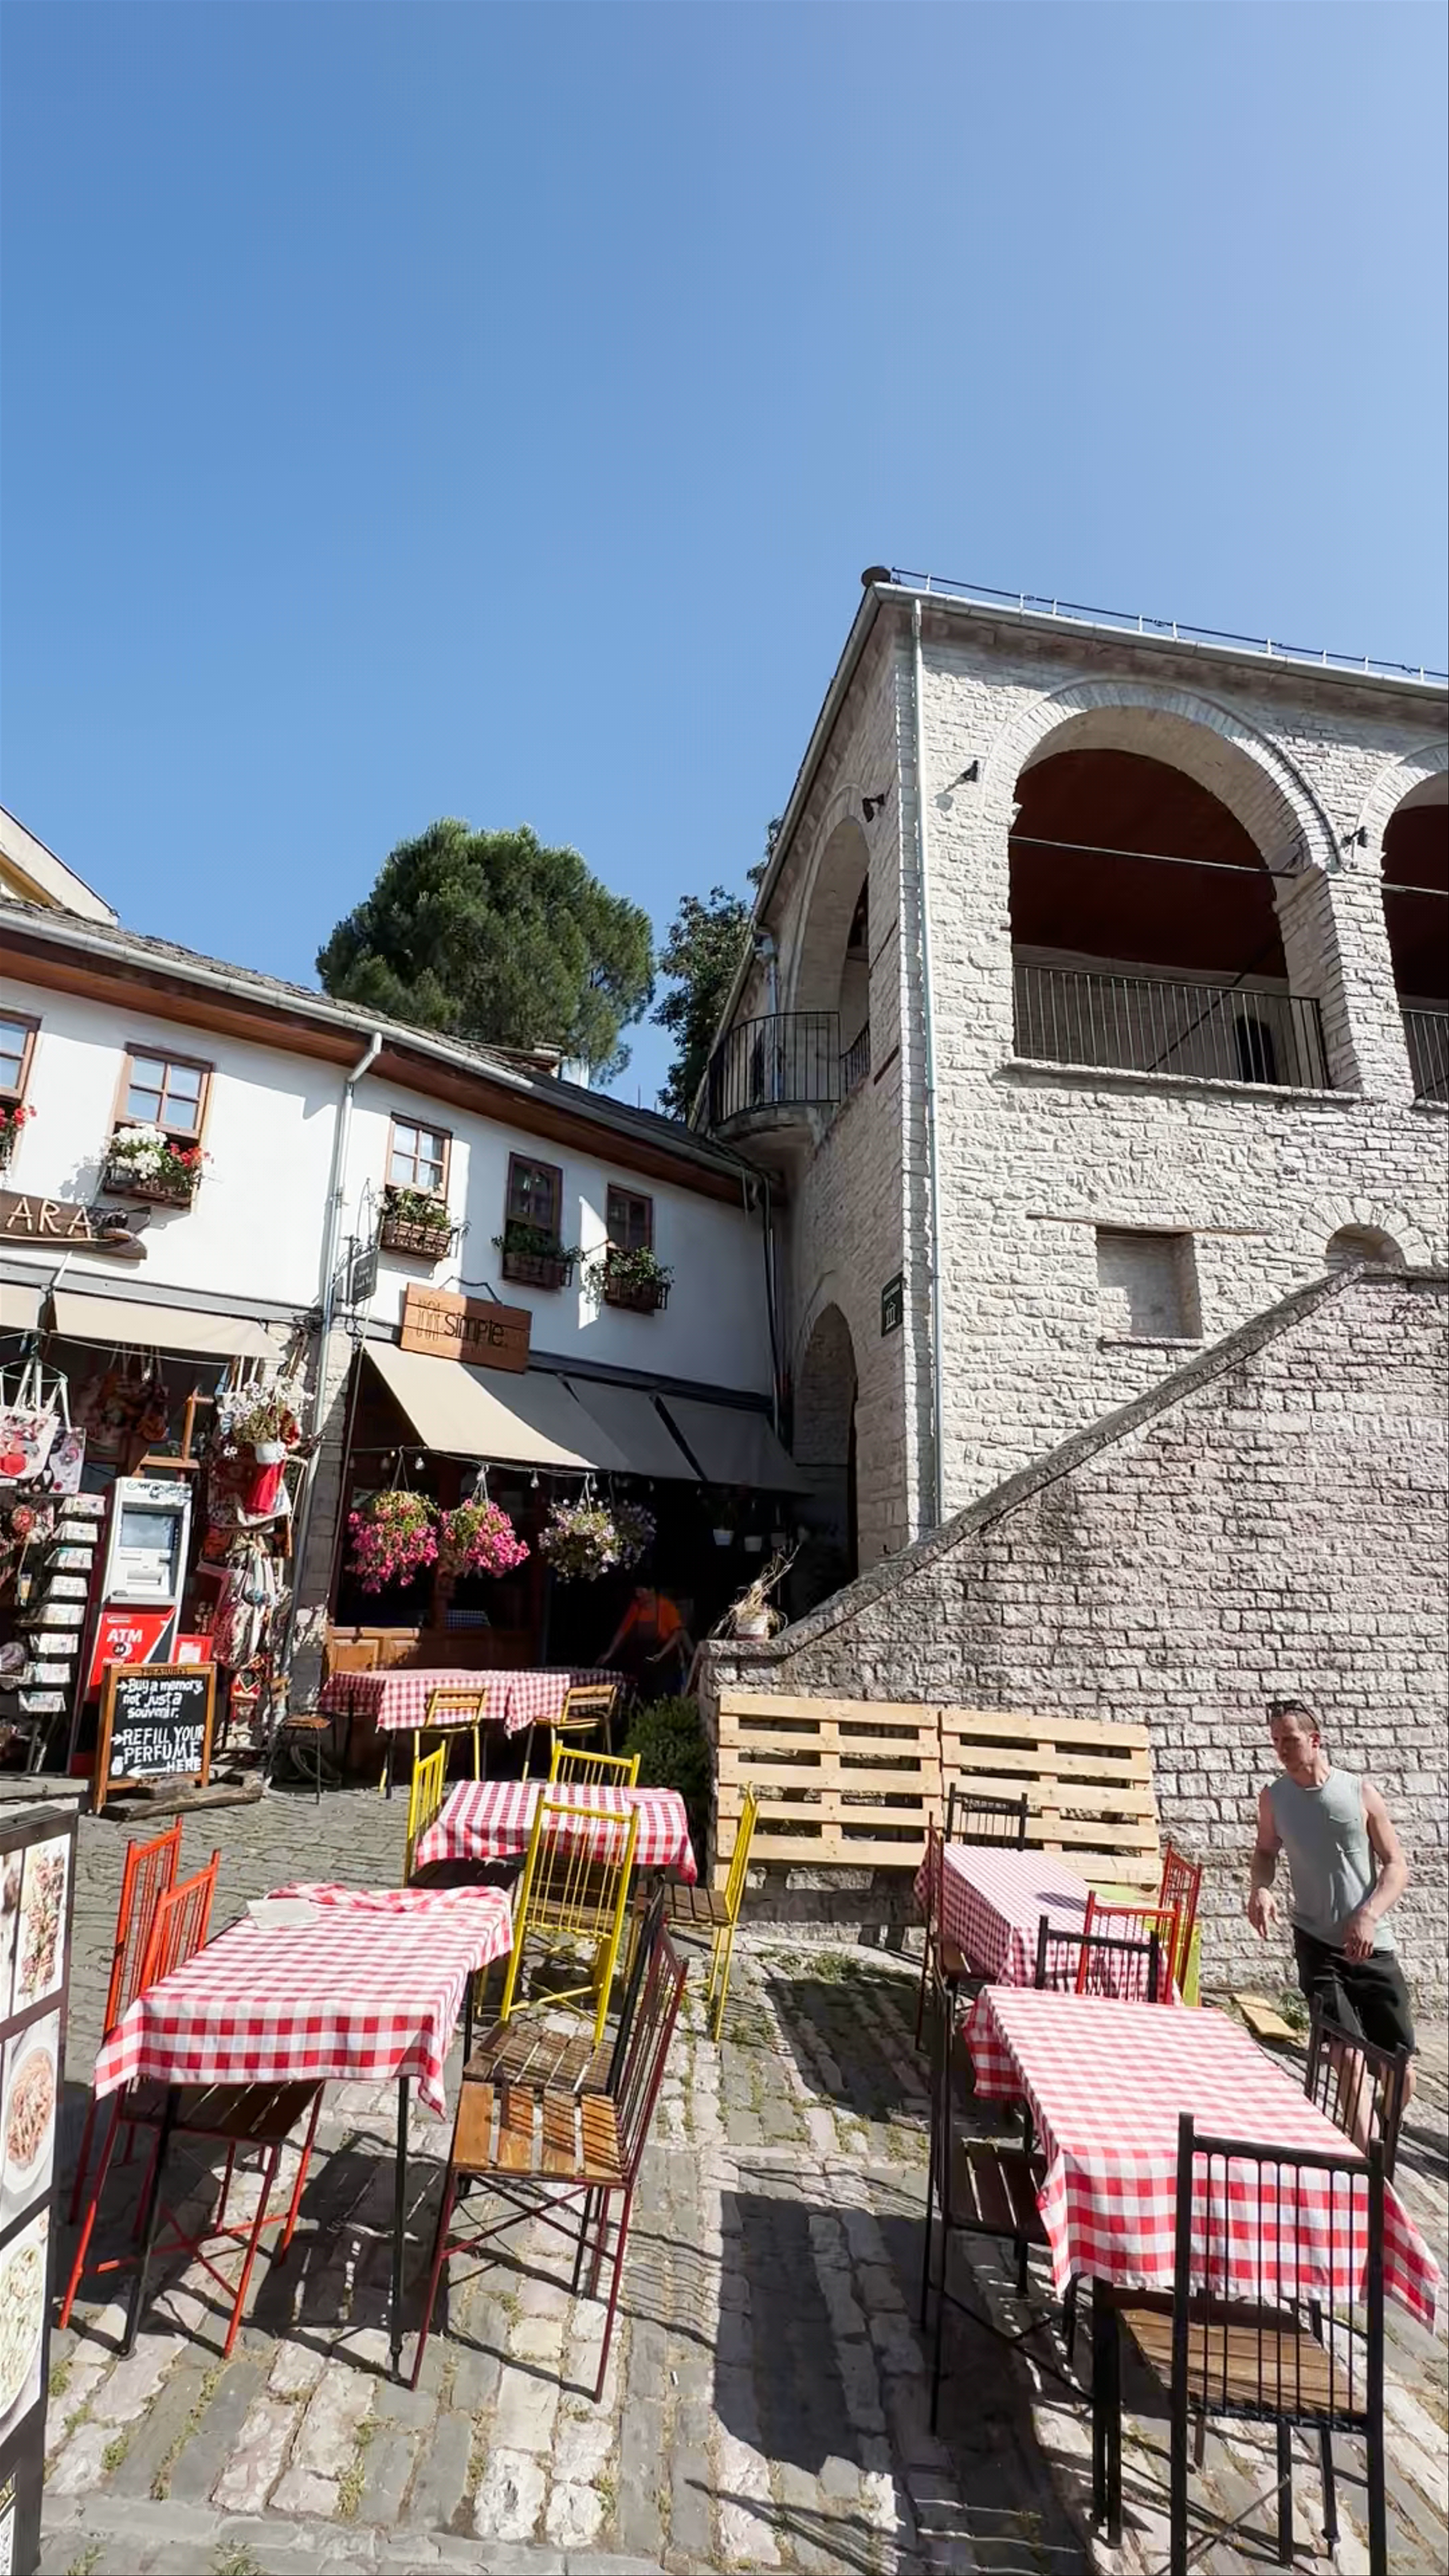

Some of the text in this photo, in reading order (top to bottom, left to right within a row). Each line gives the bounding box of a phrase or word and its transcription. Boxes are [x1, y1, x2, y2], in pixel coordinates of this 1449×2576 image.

[6, 1196, 92, 1239] ARA
[107, 1629, 143, 1642] ATM
[128, 1678, 149, 1694] Buy
[150, 1680, 158, 1693] a
[123, 1692, 182, 1708] not just a
[122, 1724, 204, 1746] REFILL YOUR
[123, 1741, 200, 1765] PERFUME
[166, 1757, 202, 1772] HERE
